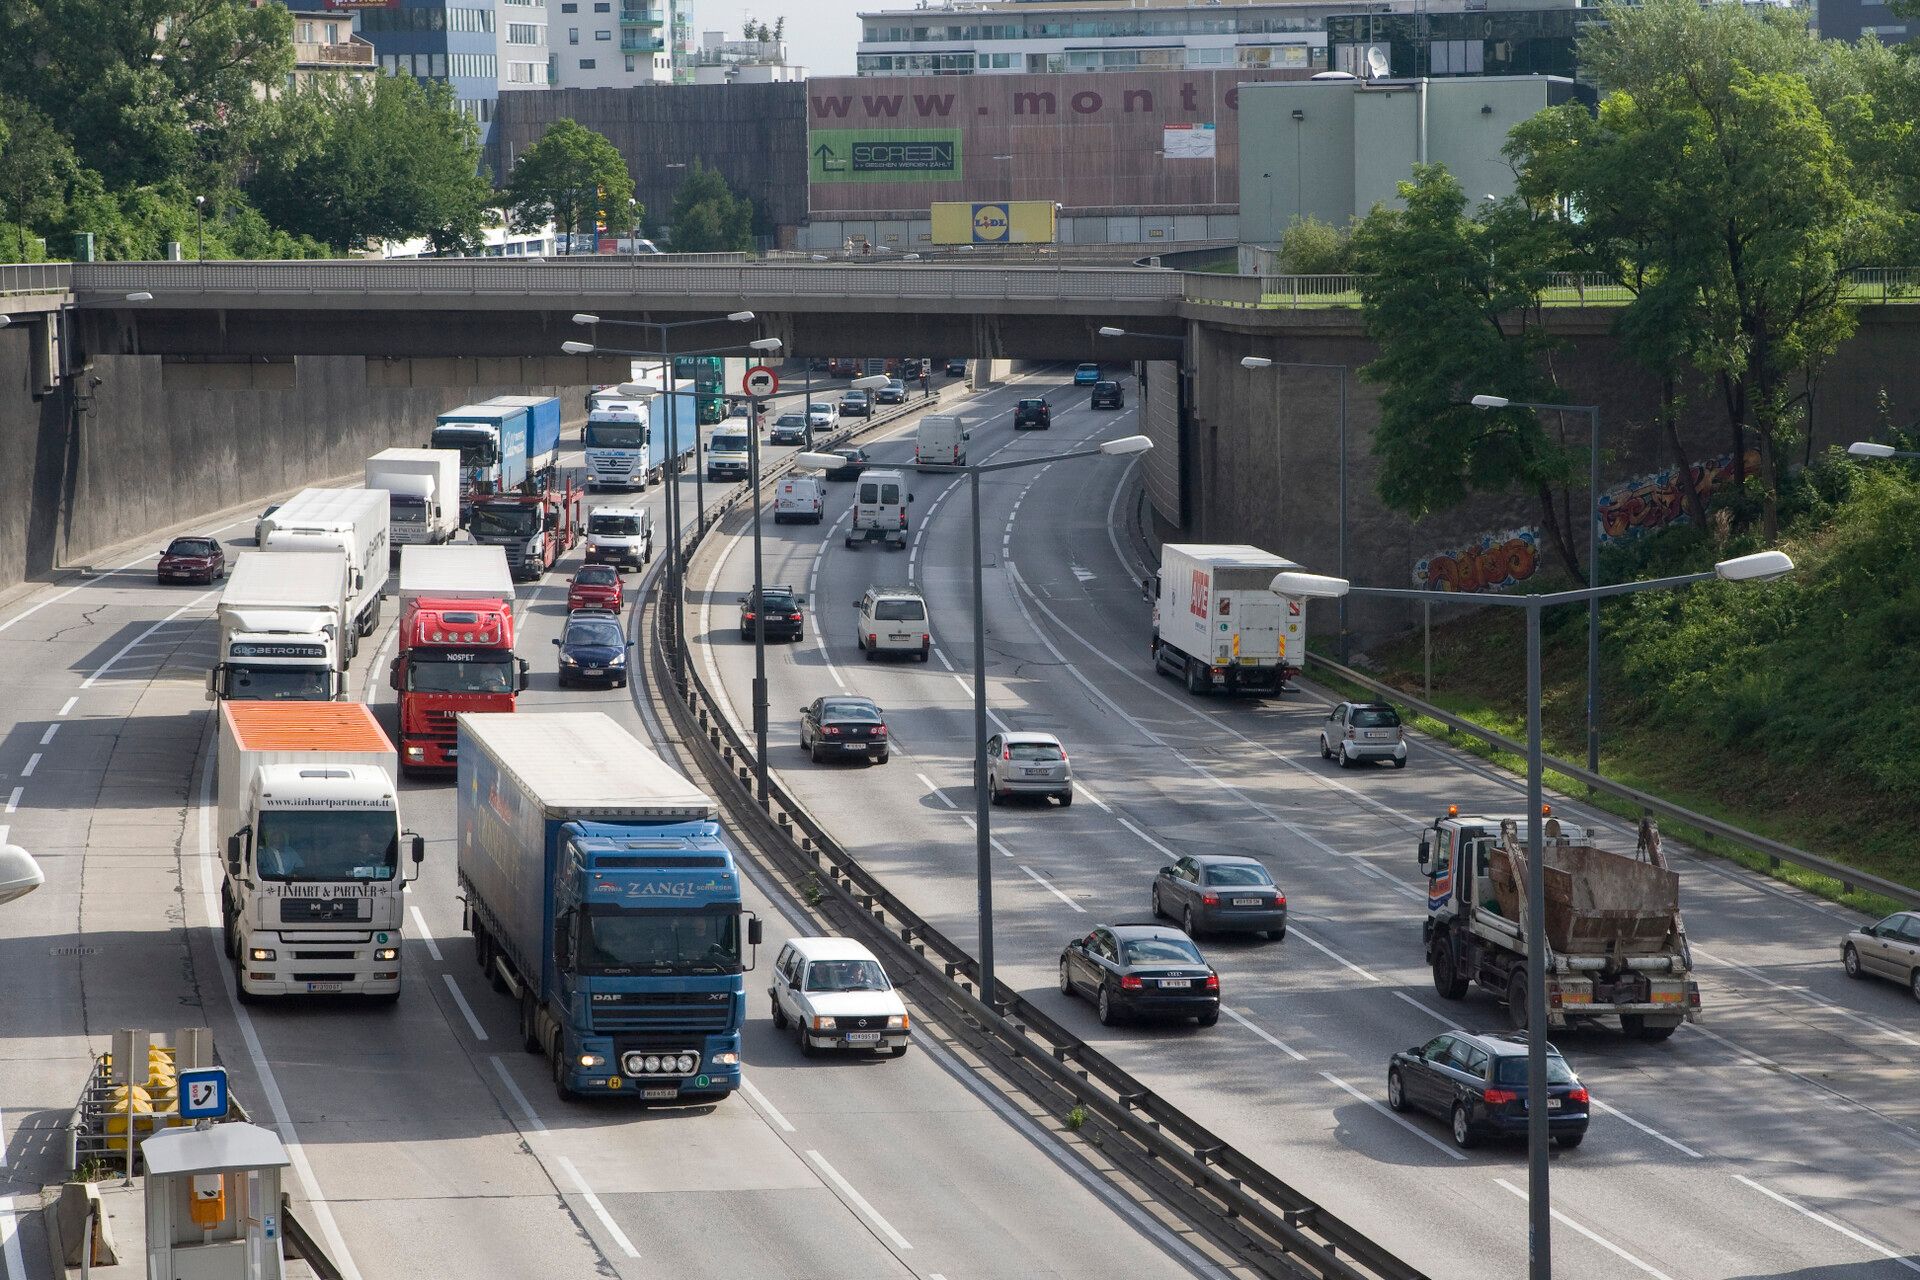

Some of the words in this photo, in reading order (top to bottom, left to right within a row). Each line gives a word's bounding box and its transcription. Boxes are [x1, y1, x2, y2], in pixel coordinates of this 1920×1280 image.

[233, 646, 323, 655] GLOBETROTTER
[447, 653, 475, 661] NOSPET
[277, 886, 320, 897] LINHART
[322, 887, 331, 898] &
[333, 886, 377, 897] PARTNER
[610, 1076, 619, 1087] H
[698, 1076, 706, 1087] L
